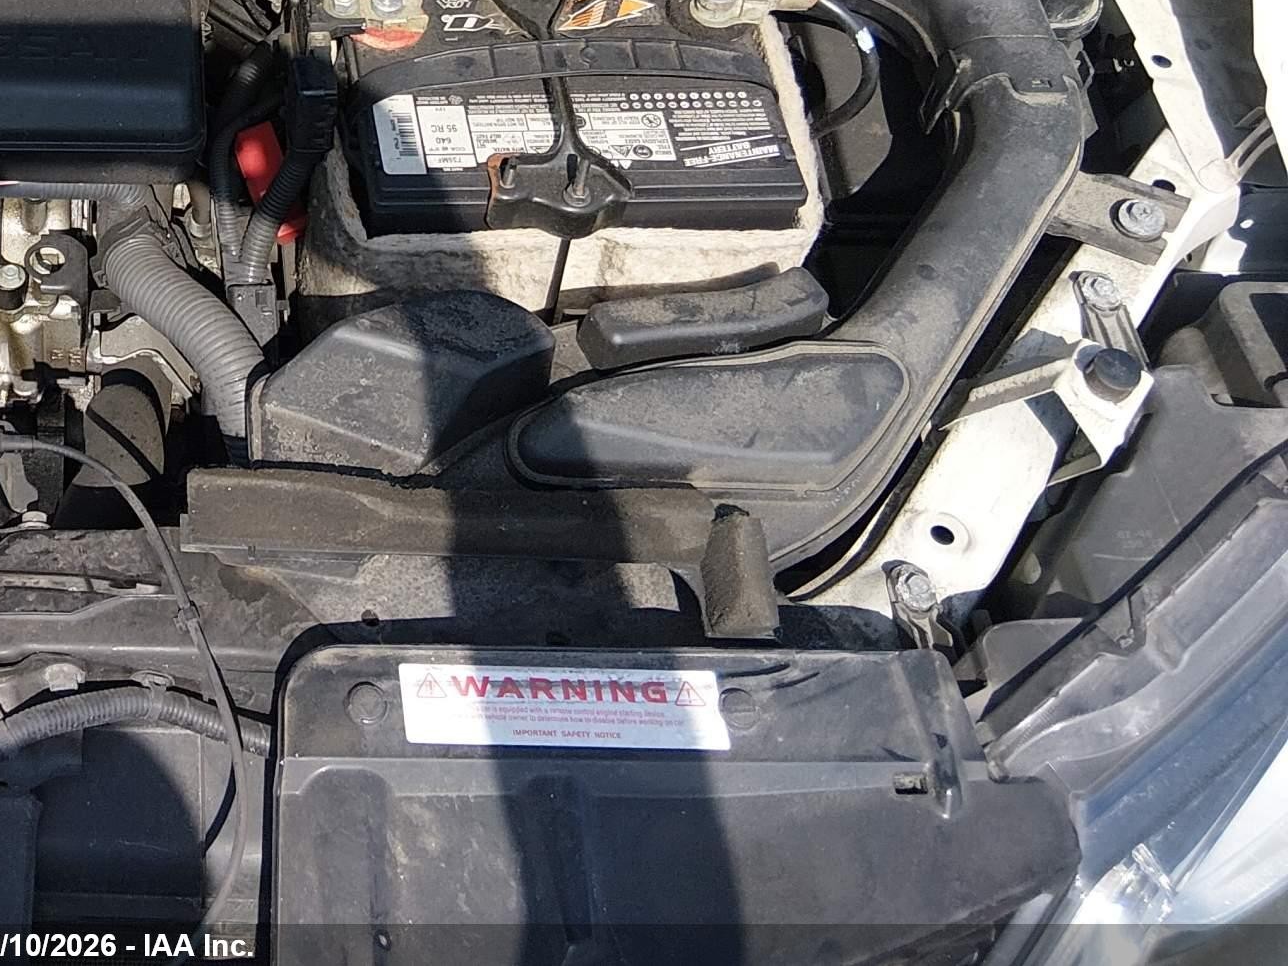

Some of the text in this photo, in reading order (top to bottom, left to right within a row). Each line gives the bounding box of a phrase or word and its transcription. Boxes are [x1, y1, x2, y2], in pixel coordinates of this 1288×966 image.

[430, 124, 444, 132] RC
[708, 141, 751, 154] BATTERY
[682, 144, 779, 166] MAINTENANCE-FREE
[450, 676, 668, 704] WARNING
[639, 718, 663, 726] working
